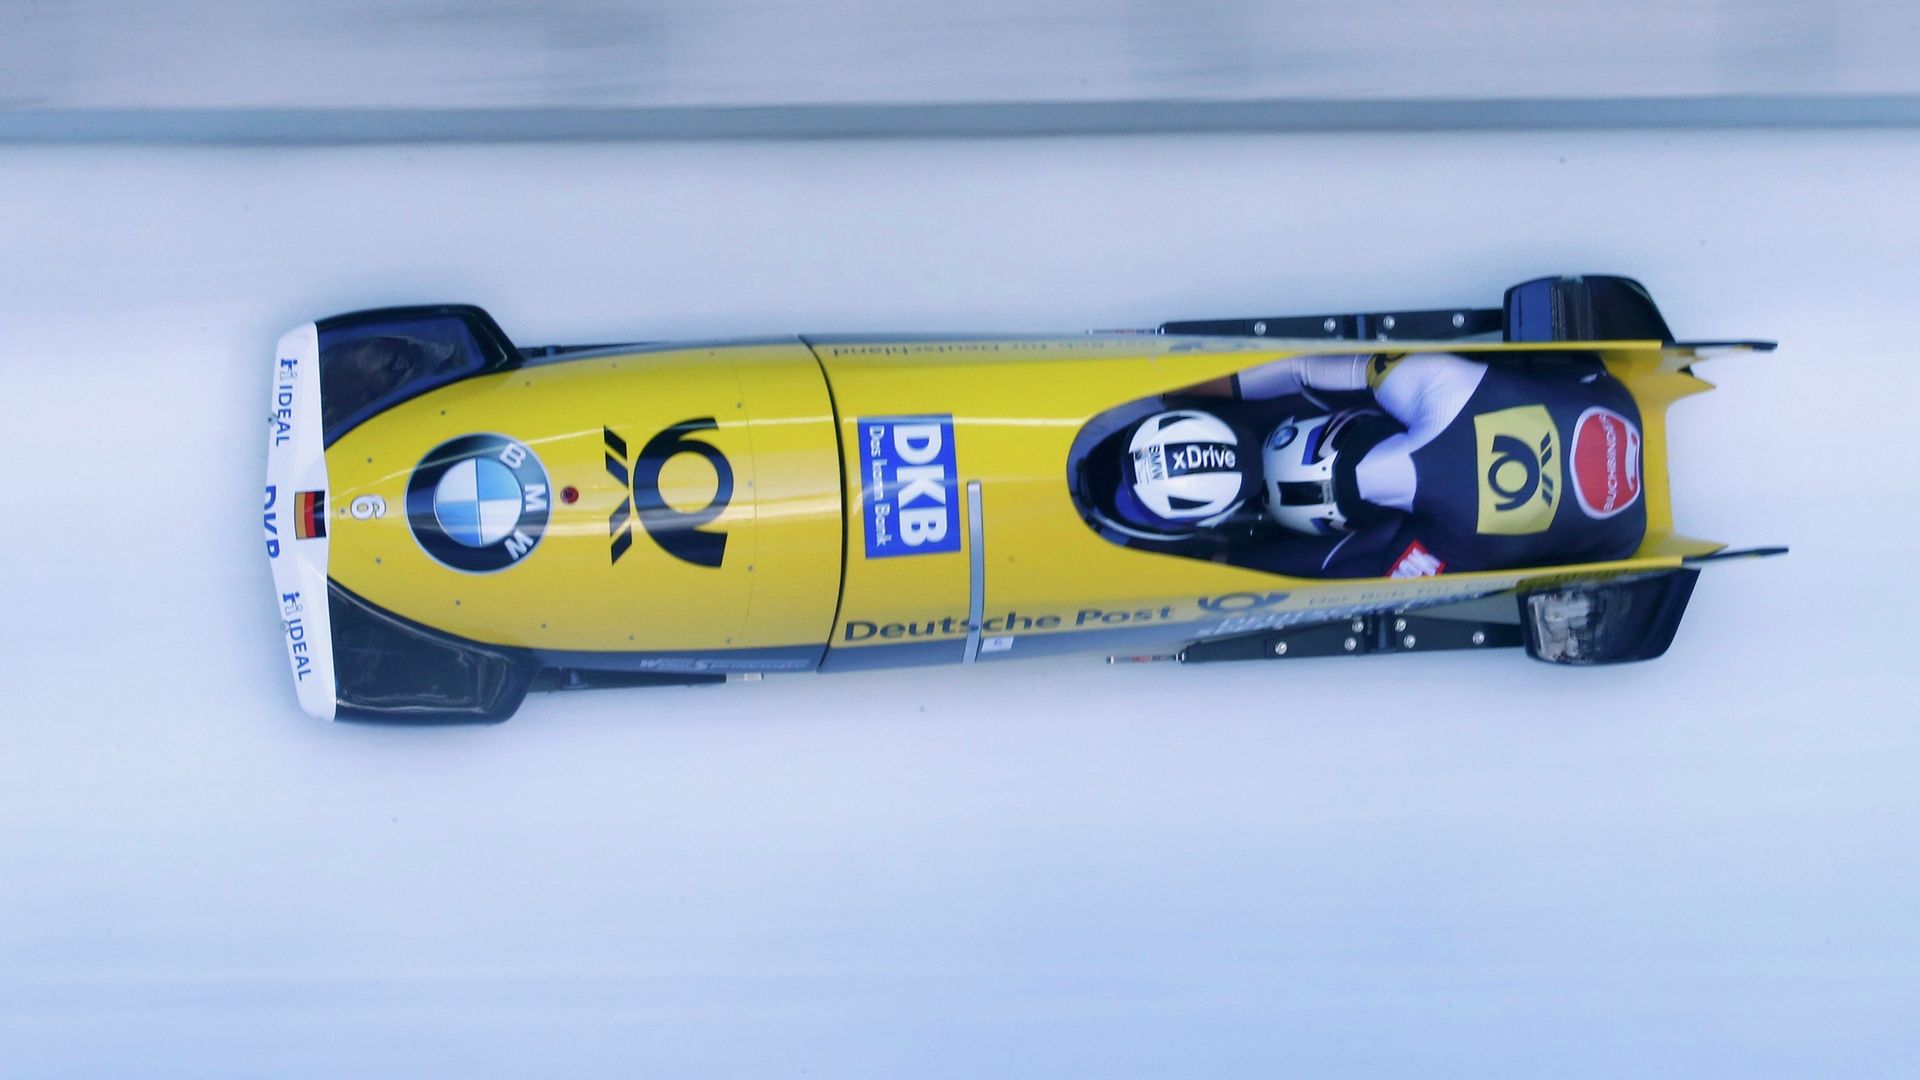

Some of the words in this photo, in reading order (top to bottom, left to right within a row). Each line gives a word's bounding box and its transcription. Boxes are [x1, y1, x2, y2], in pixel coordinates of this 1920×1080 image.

[276, 385, 293, 447] IDEAL
[869, 425, 885, 457] Das
[1172, 444, 1236, 471] xDrive
[350, 493, 386, 521] 6
[499, 443, 547, 561] BMW
[893, 424, 947, 547] DKB
[875, 503, 892, 547] Bank
[844, 610, 1062, 641] Deutsche
[1075, 605, 1176, 625] Post
[289, 619, 312, 682] IDEAL
